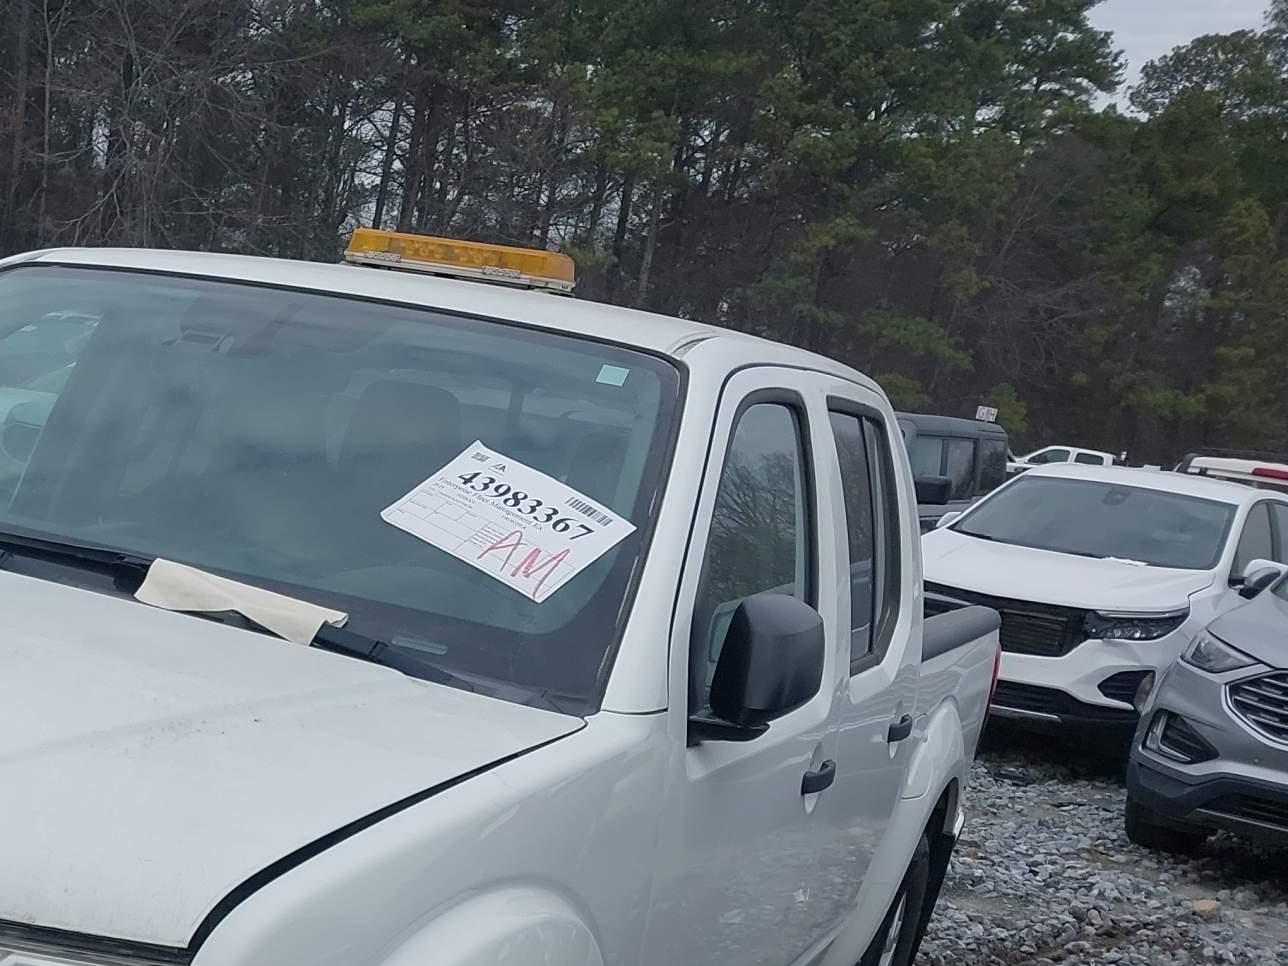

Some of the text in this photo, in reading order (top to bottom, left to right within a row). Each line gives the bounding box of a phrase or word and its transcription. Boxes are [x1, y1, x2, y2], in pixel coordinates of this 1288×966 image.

[457, 471, 595, 540] 43983367
[490, 500, 533, 526] Management
[476, 529, 570, 599] AM
